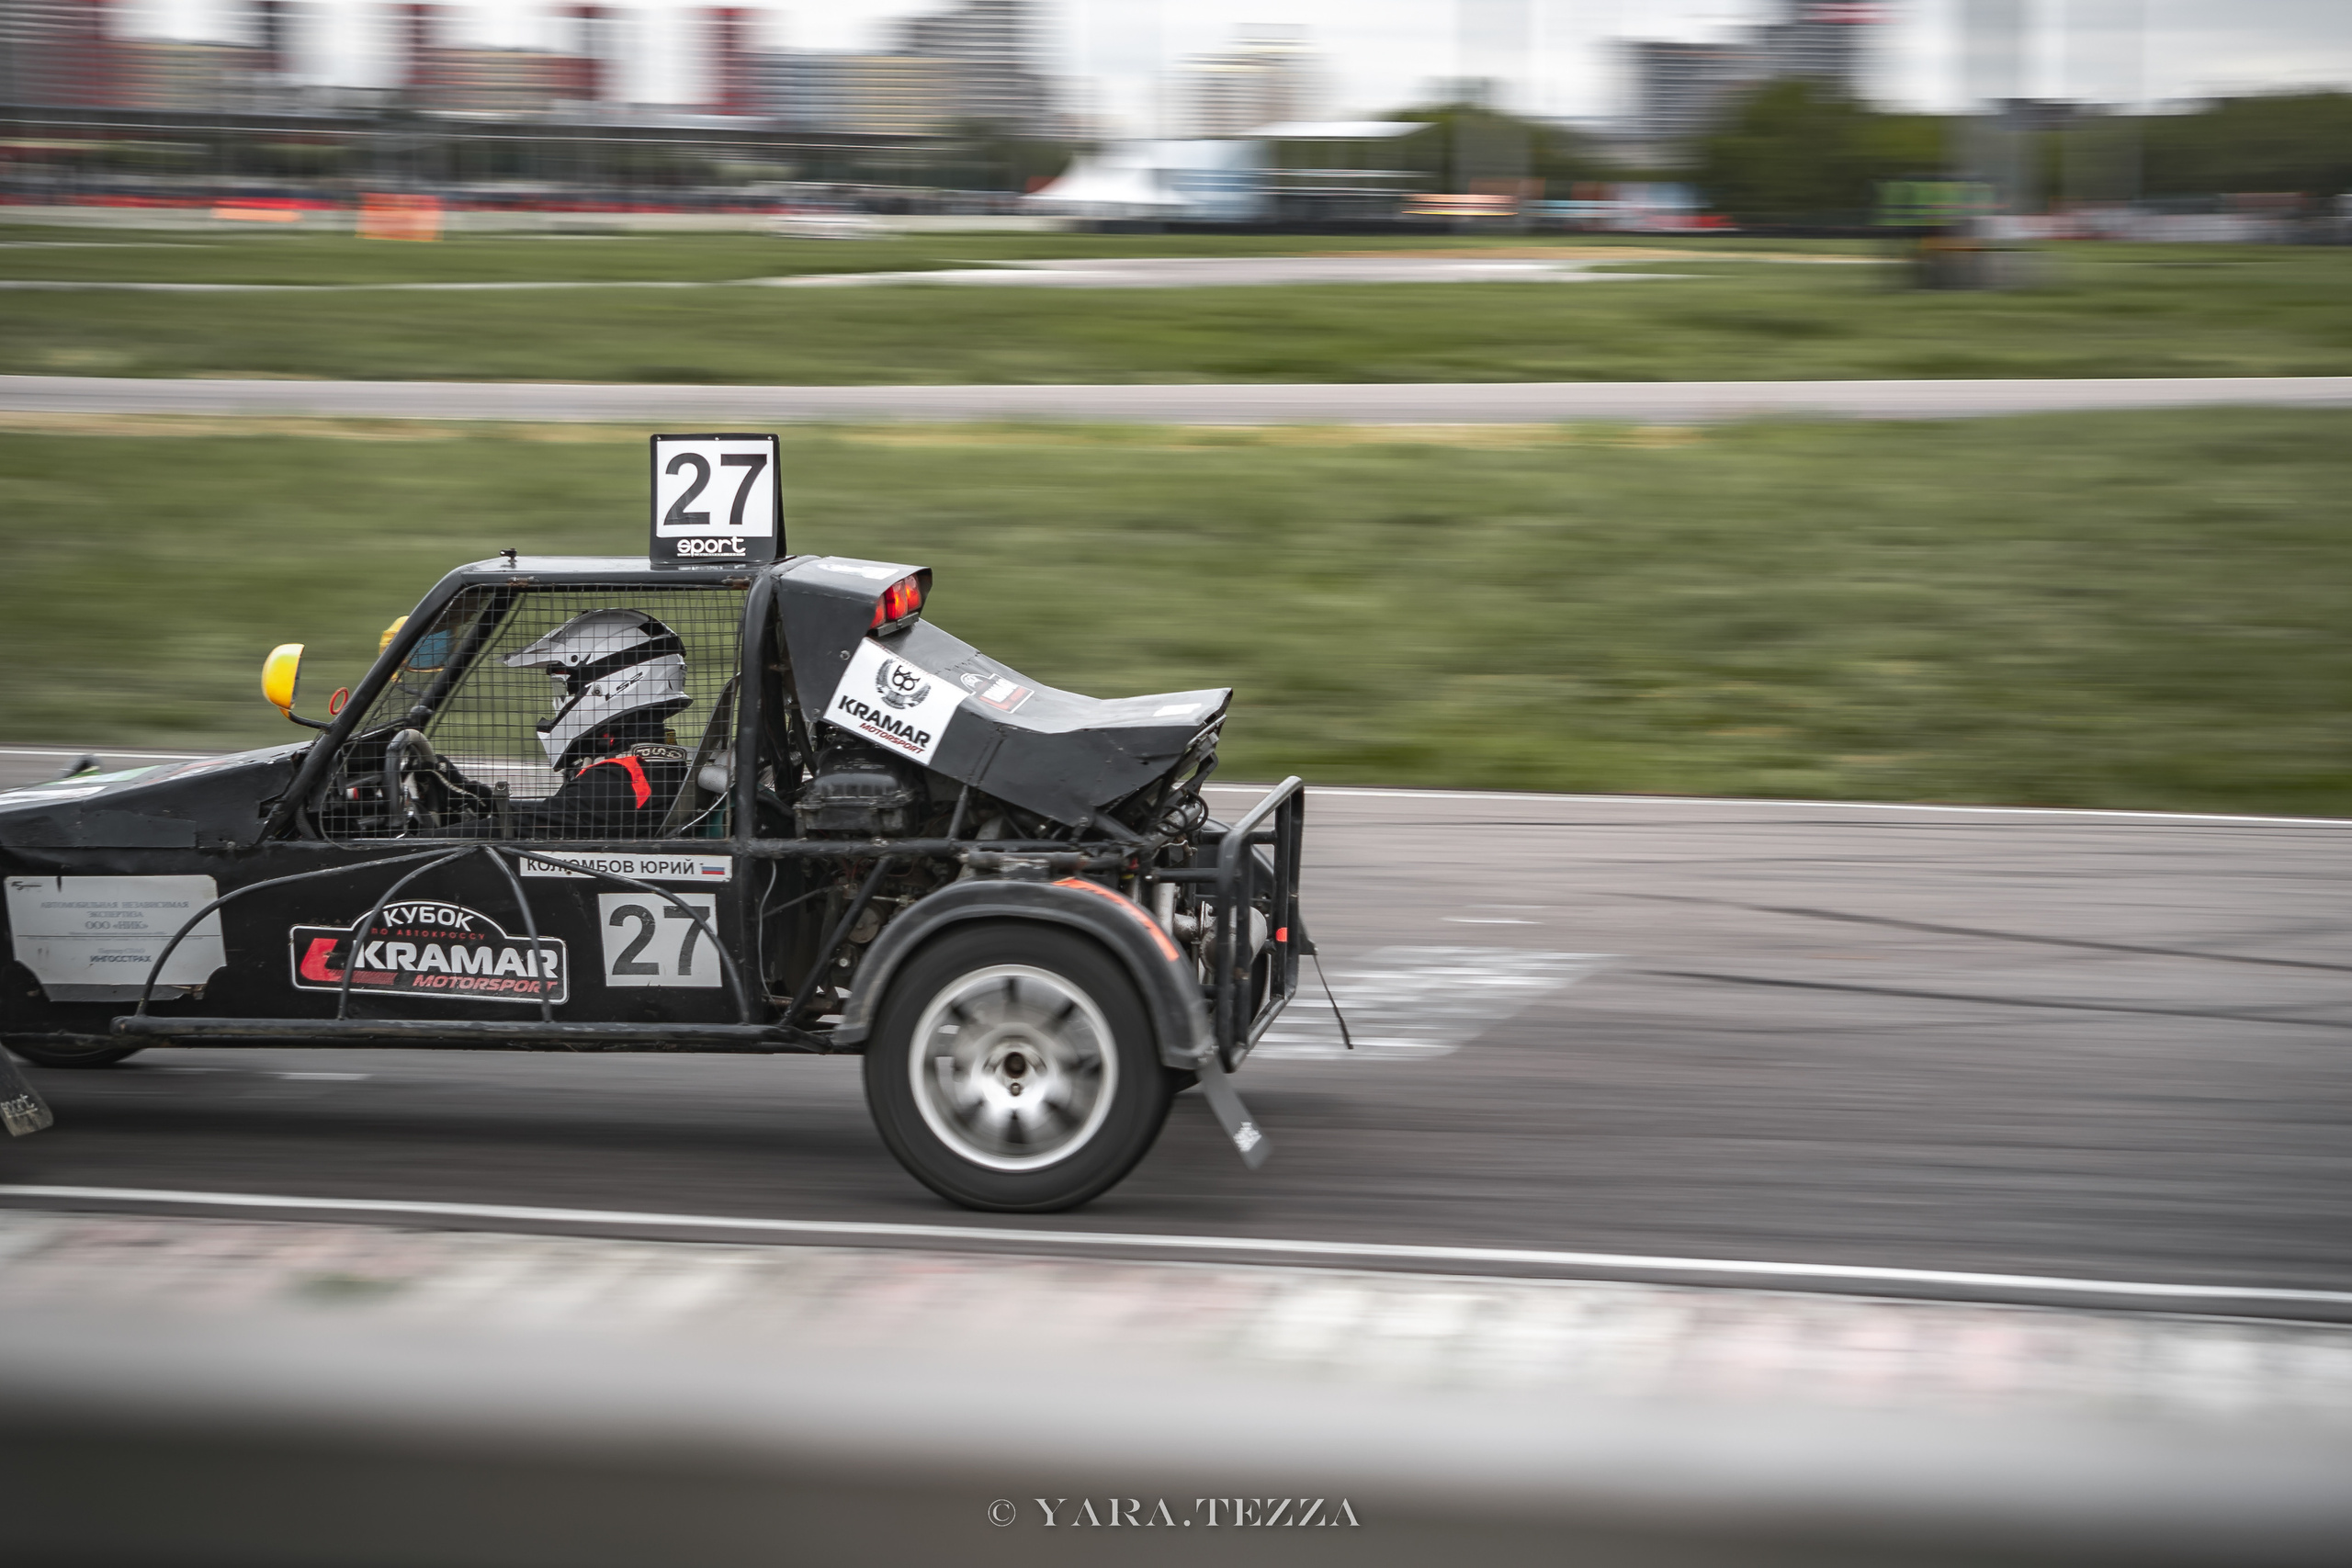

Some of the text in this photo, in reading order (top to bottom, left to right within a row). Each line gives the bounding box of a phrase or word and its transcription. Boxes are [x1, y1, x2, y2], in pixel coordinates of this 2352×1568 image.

[663, 452, 768, 526] 27
[676, 536, 746, 557] sport
[605, 671, 643, 702] LS2
[837, 695, 932, 749] KRAMAR
[859, 722, 925, 754] MOTORSPORT
[640, 858, 695, 875] ЮРИЙ
[382, 906, 475, 931] КУБОК
[370, 927, 485, 941] ПО АВТОКРОССУ
[608, 904, 711, 976] 27
[89, 954, 153, 964] ИНГОССТРАХ
[353, 939, 559, 979] KRAMAR
[413, 974, 559, 995] MOTORSPORT
